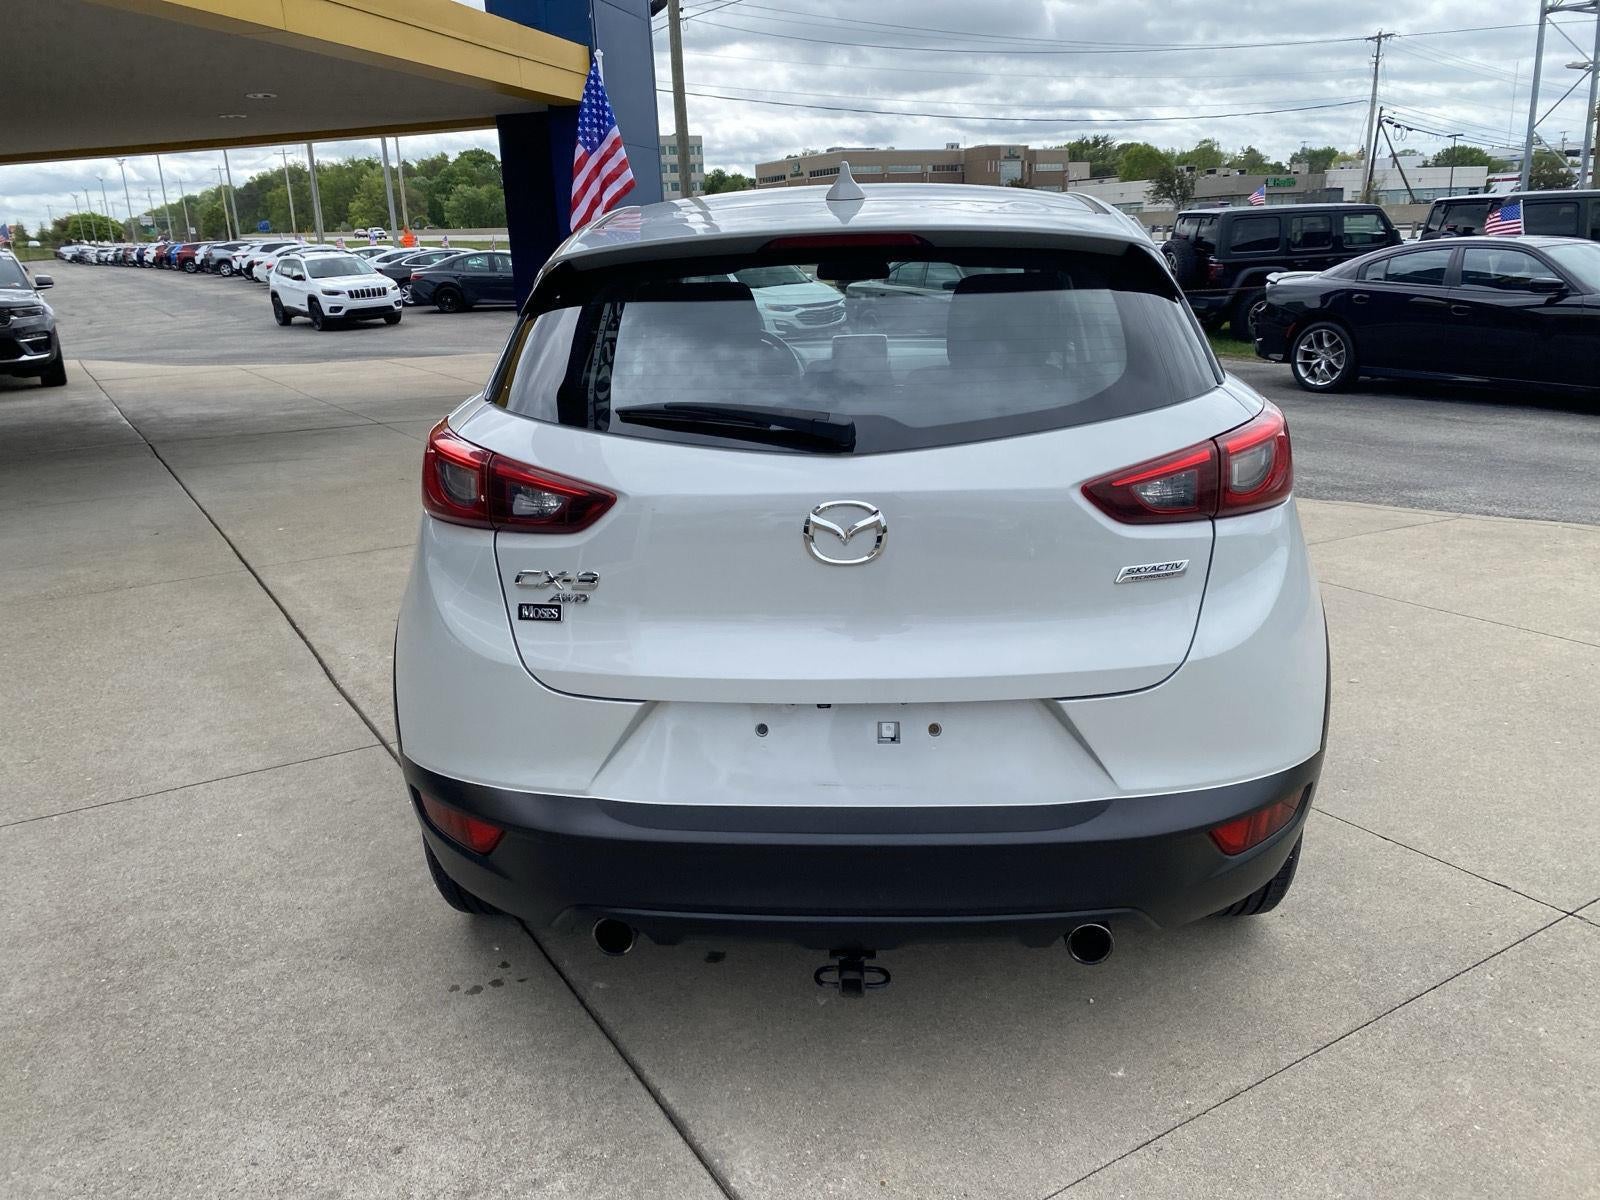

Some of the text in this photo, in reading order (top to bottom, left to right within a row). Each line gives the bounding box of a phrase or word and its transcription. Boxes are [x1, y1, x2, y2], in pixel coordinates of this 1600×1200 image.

[1126, 562, 1183, 575] SKYACTIV
[514, 569, 600, 591] CX-3
[1131, 572, 1177, 580] TECHNOLOGY
[548, 593, 590, 603] AWD
